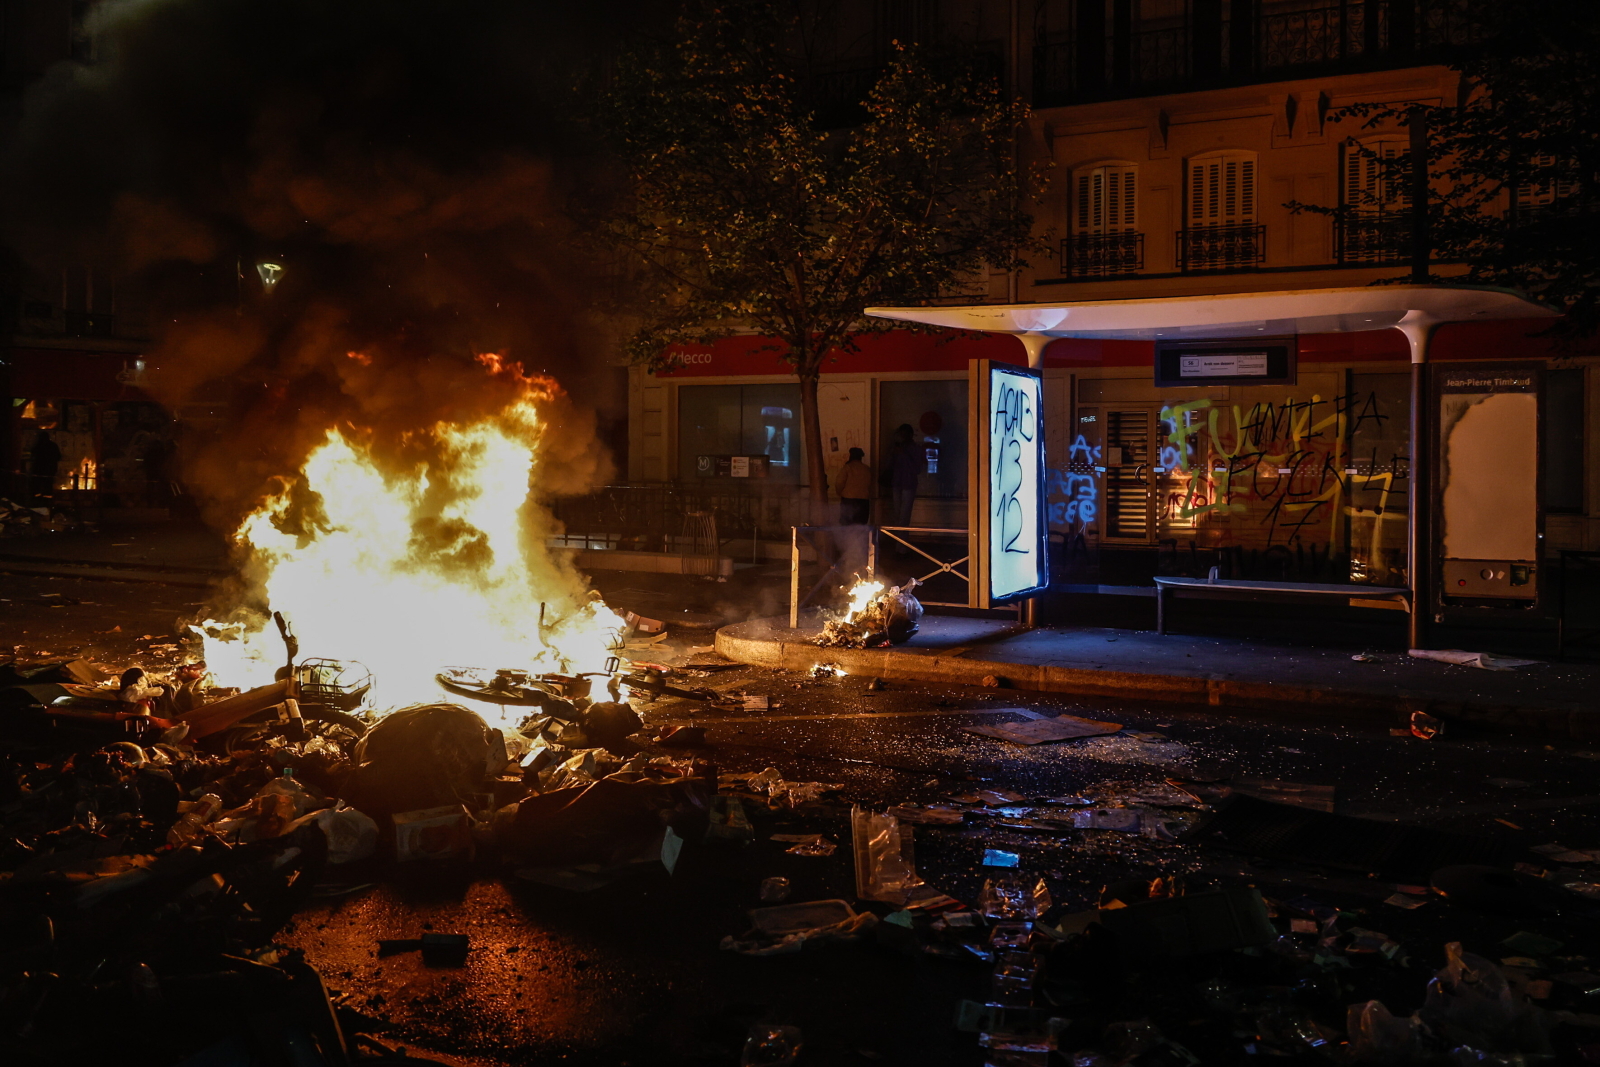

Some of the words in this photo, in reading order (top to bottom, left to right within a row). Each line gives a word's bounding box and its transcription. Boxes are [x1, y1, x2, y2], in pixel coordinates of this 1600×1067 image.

[666, 350, 712, 365] Adecco
[1446, 378, 1492, 387] Jean-Pierre
[1494, 377, 1531, 387] Timbaud
[994, 382, 1035, 443] ACAB
[1162, 394, 1346, 470] FUCK
[995, 437, 1024, 498] 13
[1226, 449, 1348, 505] FUCK
[1362, 447, 1410, 494] LE
[996, 492, 1030, 554] 12
[1260, 495, 1329, 547] 17
